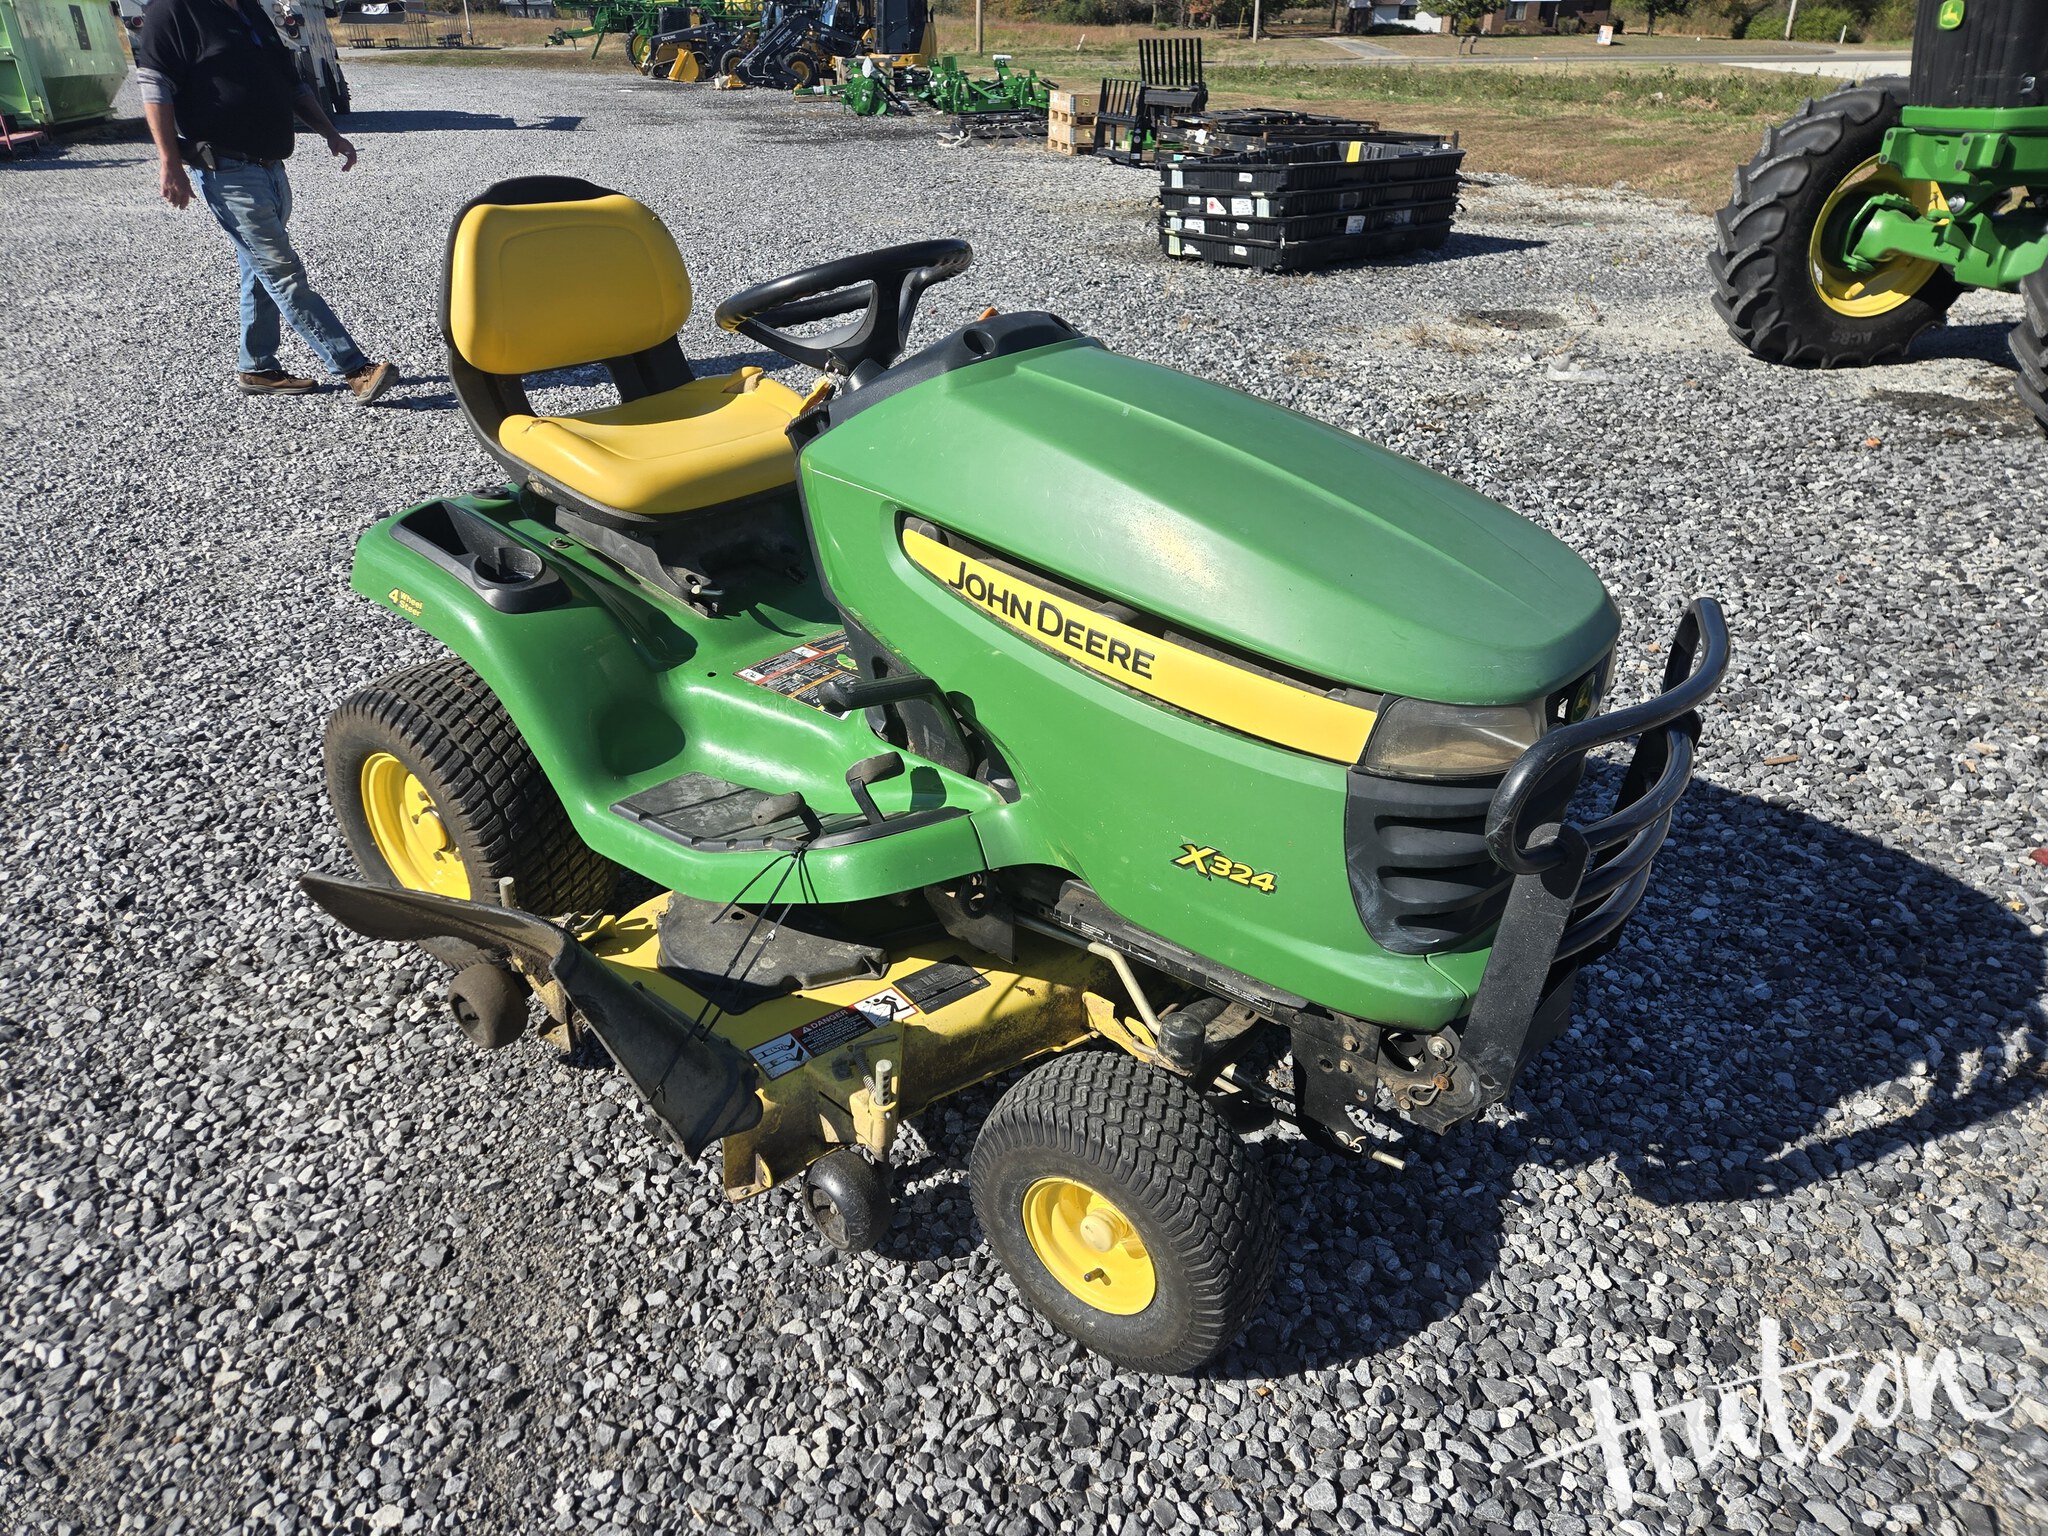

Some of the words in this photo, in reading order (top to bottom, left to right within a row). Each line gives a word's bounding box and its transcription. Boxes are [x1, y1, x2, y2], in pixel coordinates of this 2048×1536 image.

[388, 588, 400, 605] 4
[400, 591, 423, 610] Wheel
[399, 599, 421, 617] Steer
[949, 561, 1032, 626] JOHN
[1037, 600, 1155, 680] DEERE
[1171, 843, 1277, 894] X324
[810, 1009, 849, 1029] DANGER
